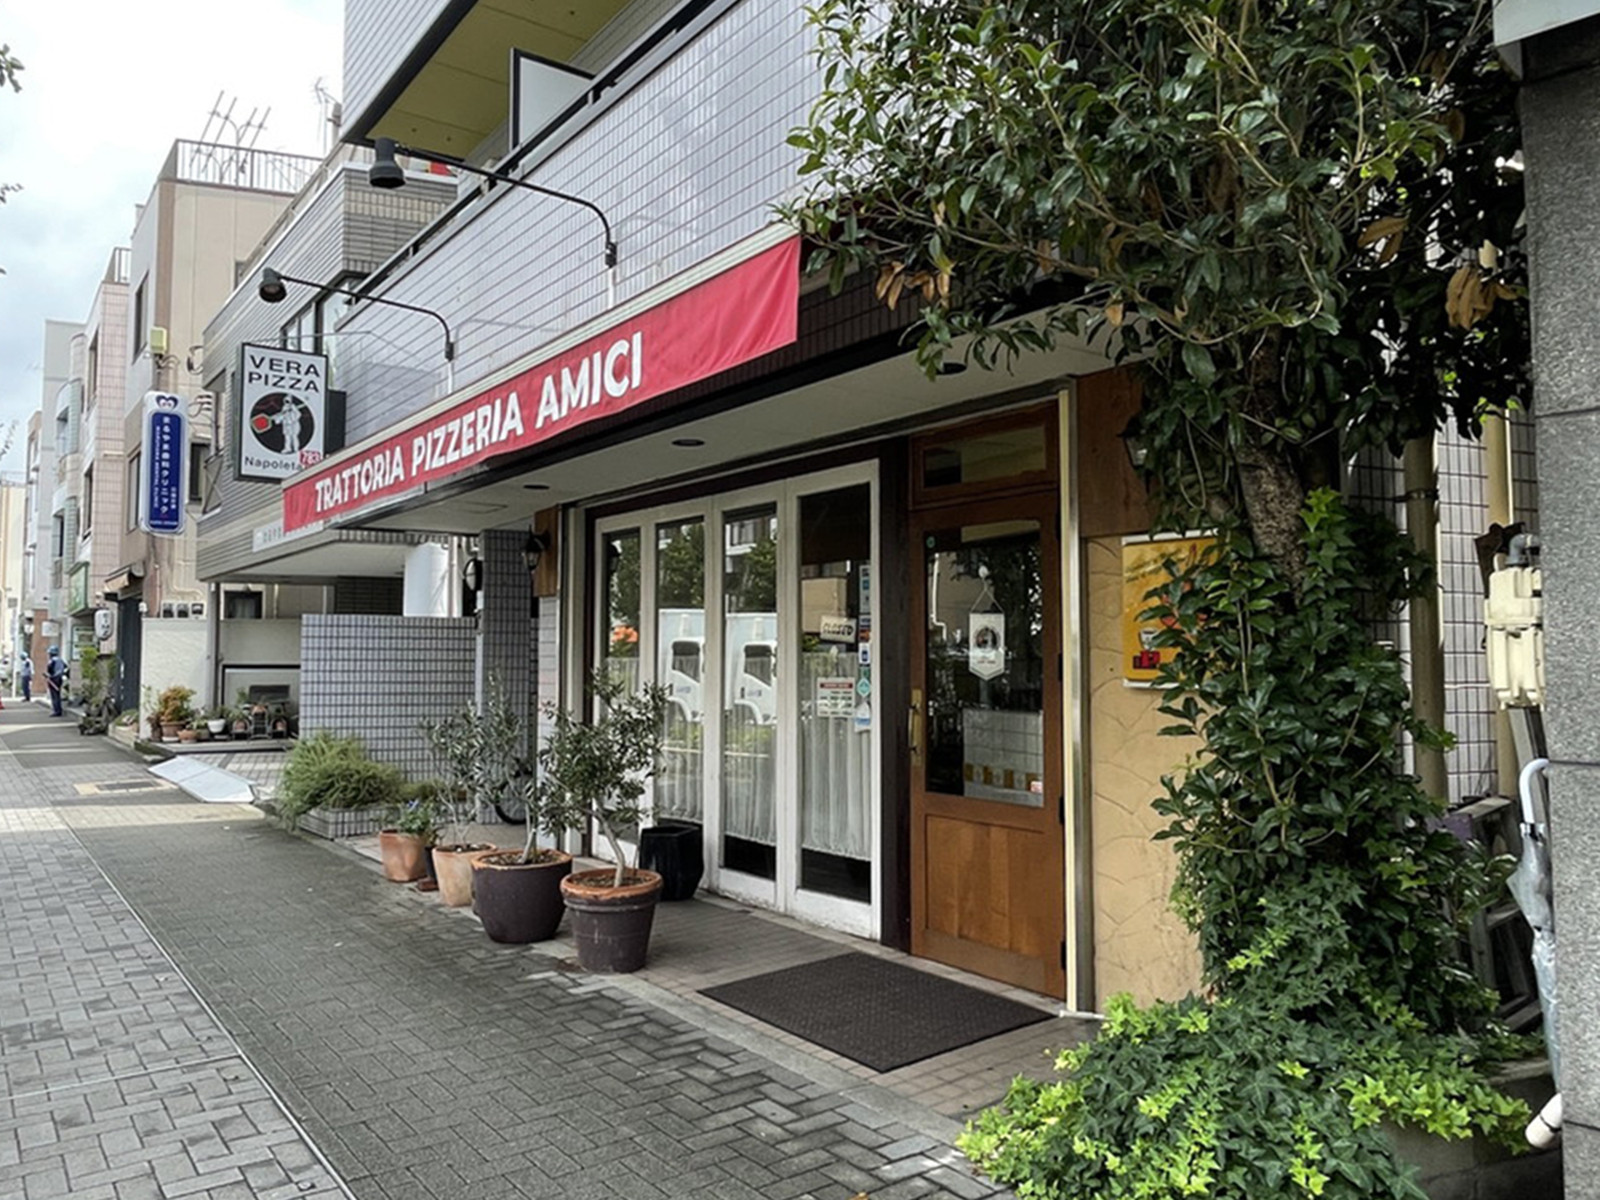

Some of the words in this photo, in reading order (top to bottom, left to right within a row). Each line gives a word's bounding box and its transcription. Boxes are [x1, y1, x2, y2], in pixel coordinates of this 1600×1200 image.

[250, 354, 320, 378] VERA
[248, 371, 319, 393] PIZZA
[315, 445, 405, 513] TRATTORIA
[411, 391, 524, 477] PIZZERIA
[535, 331, 642, 429] AMICI
